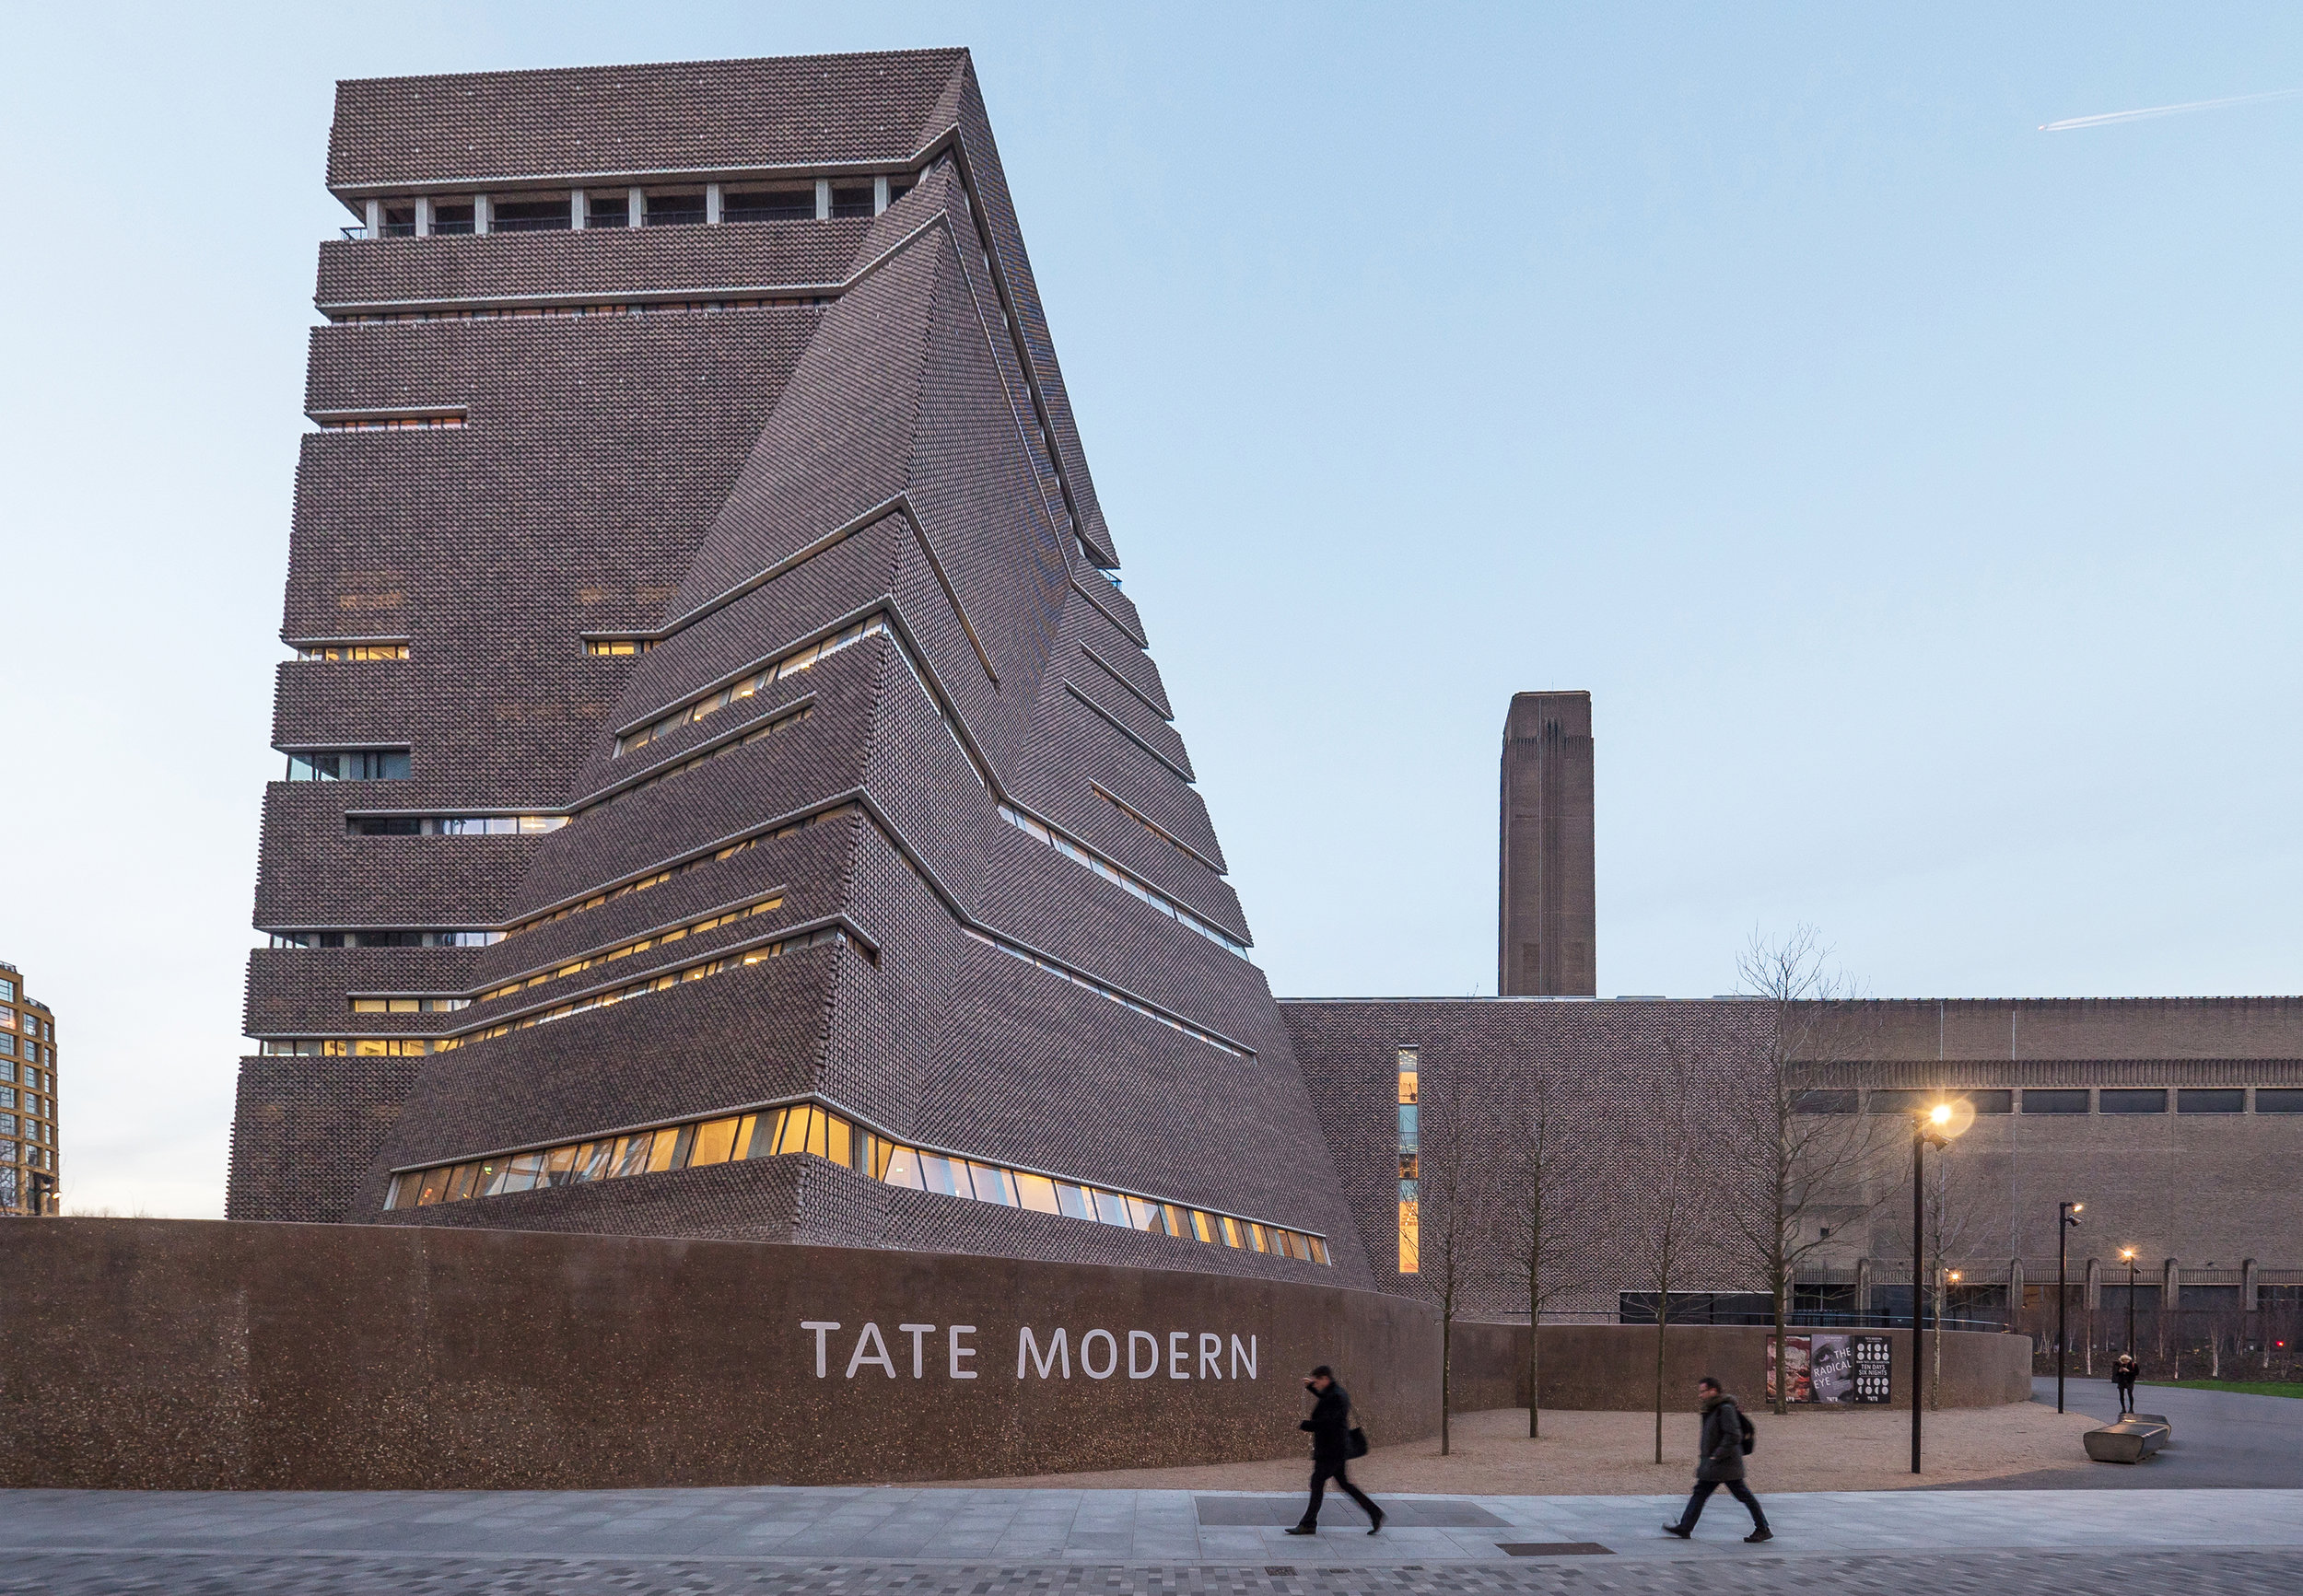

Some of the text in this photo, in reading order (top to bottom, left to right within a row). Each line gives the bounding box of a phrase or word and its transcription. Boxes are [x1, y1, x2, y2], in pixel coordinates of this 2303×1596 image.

[801, 1321, 1257, 1380] TATE MODERN
[1834, 1347, 1852, 1359] THE
[1814, 1359, 1852, 1377] RADICAL
[1814, 1377, 1831, 1390] EYE
